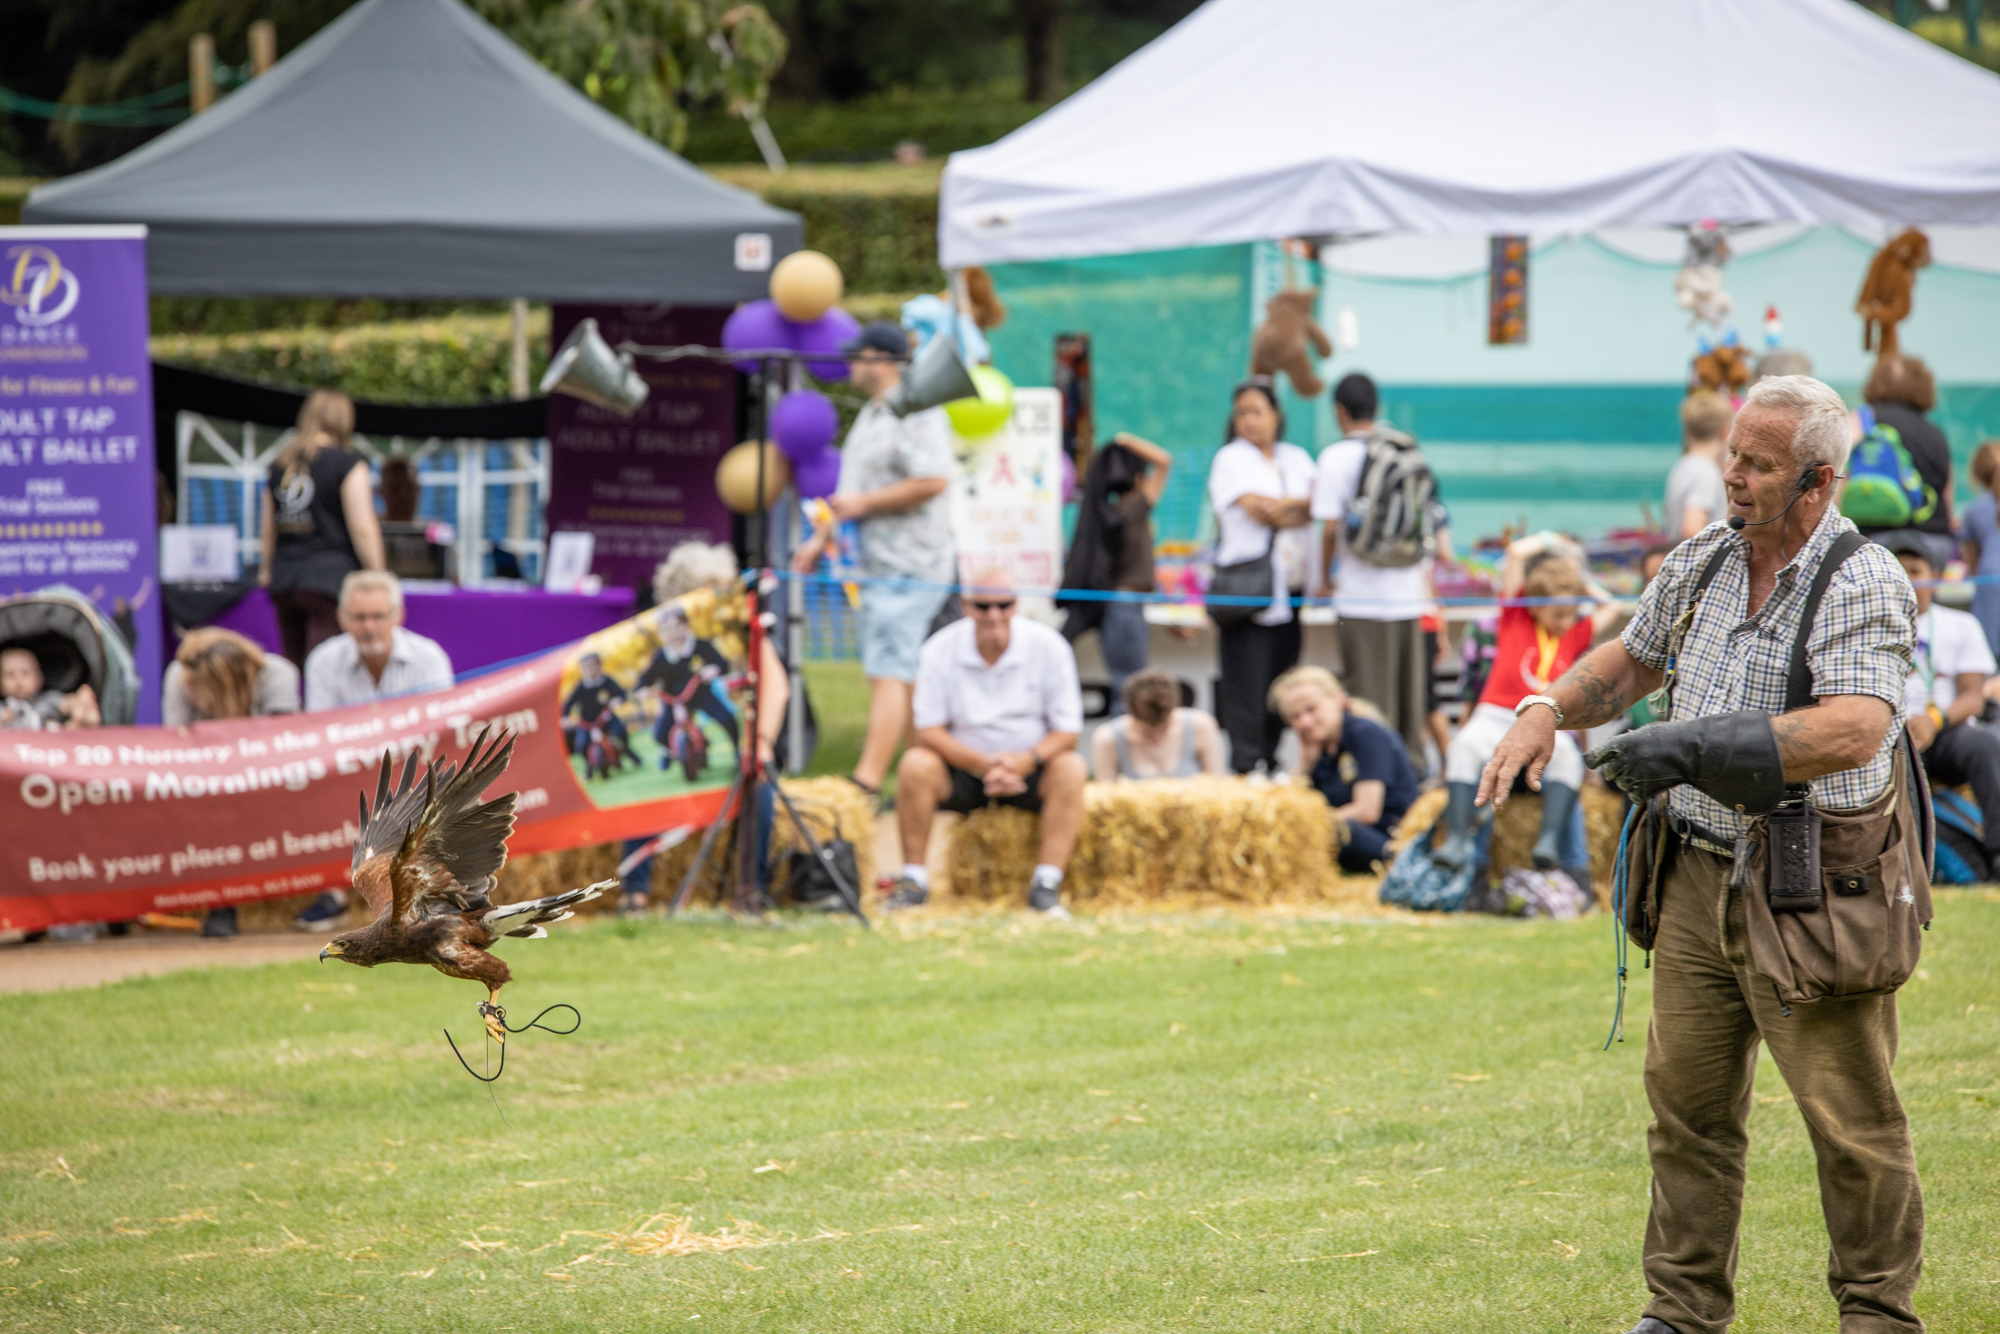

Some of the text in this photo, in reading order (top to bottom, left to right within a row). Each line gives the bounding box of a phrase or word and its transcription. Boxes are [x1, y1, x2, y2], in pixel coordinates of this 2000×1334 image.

[62, 406, 116, 435] TAP
[42, 436, 139, 465] BALLET
[14, 743, 67, 767] Top
[73, 743, 113, 766] 20
[119, 741, 232, 765] Nursery
[238, 736, 267, 758] in
[273, 730, 321, 755] the
[326, 718, 384, 743] East
[389, 705, 421, 728] of
[20, 708, 538, 815] Open Mornings Every Term
[28, 854, 96, 883] Book
[102, 853, 164, 883] your
[170, 841, 244, 876] place
[248, 838, 279, 862] at
